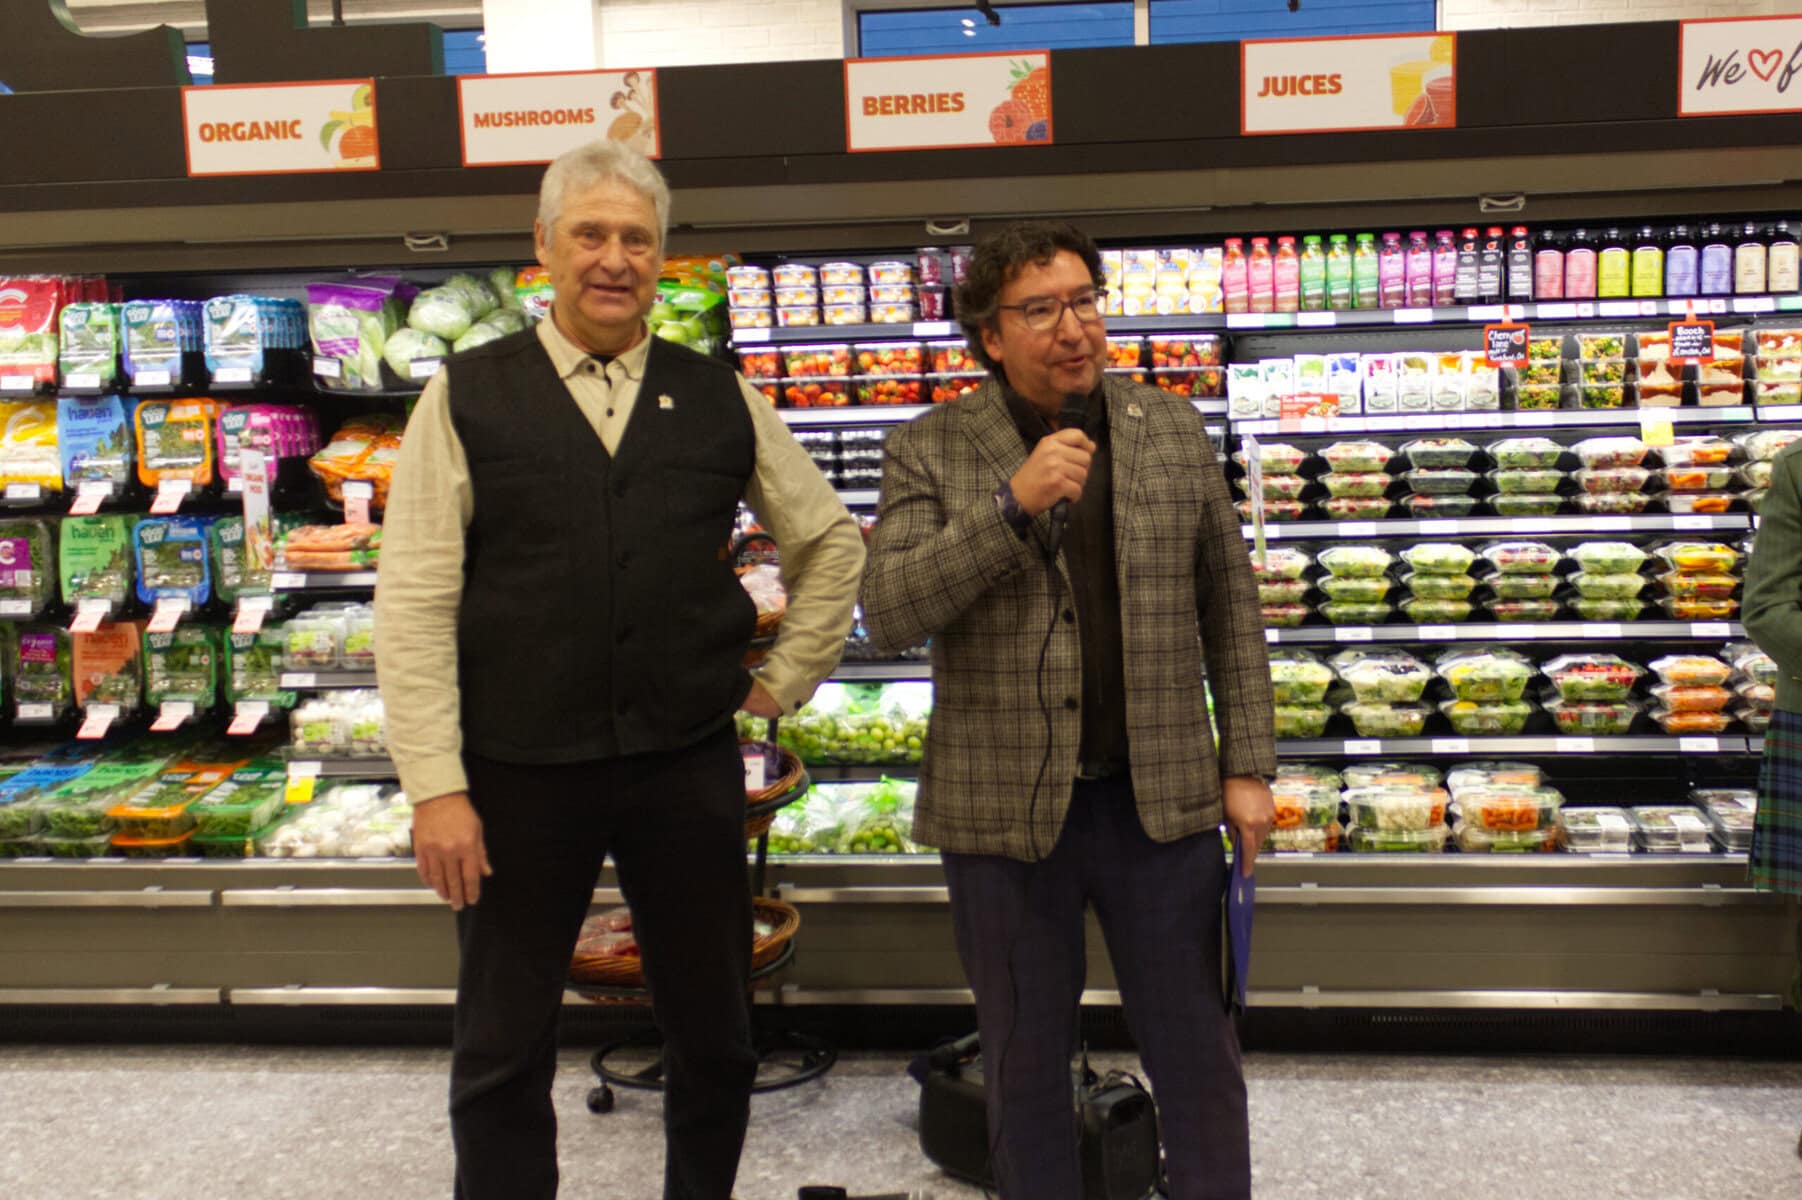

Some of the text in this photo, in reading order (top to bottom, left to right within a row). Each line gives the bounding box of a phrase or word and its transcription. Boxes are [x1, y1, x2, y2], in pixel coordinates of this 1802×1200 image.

[1696, 49, 1747, 90] We
[1257, 73, 1343, 97] JUICES
[862, 91, 965, 116] BERRIES
[473, 107, 595, 128] MUSHROOMS
[199, 119, 302, 142] ORGANIC
